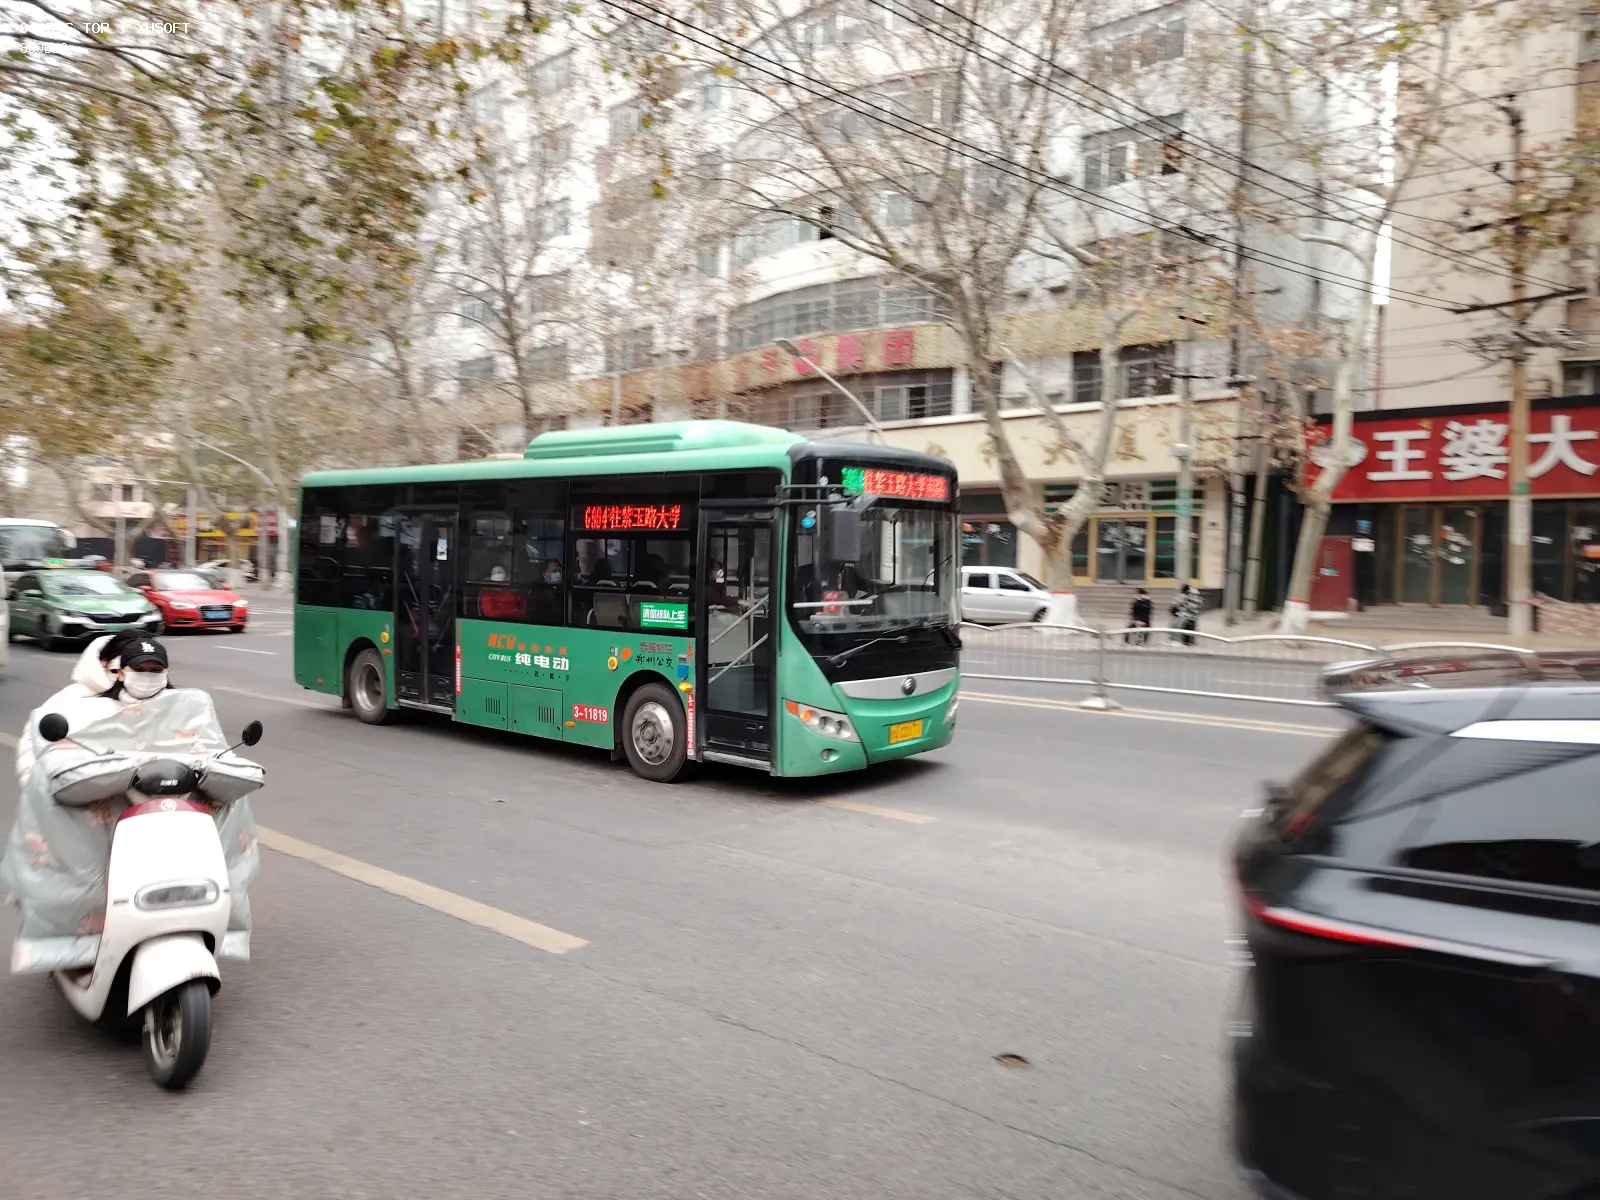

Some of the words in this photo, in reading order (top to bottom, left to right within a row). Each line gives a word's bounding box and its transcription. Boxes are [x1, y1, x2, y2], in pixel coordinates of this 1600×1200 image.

[515, 652, 569, 671] 纯电动
[573, 706, 608, 722] 3-11819
